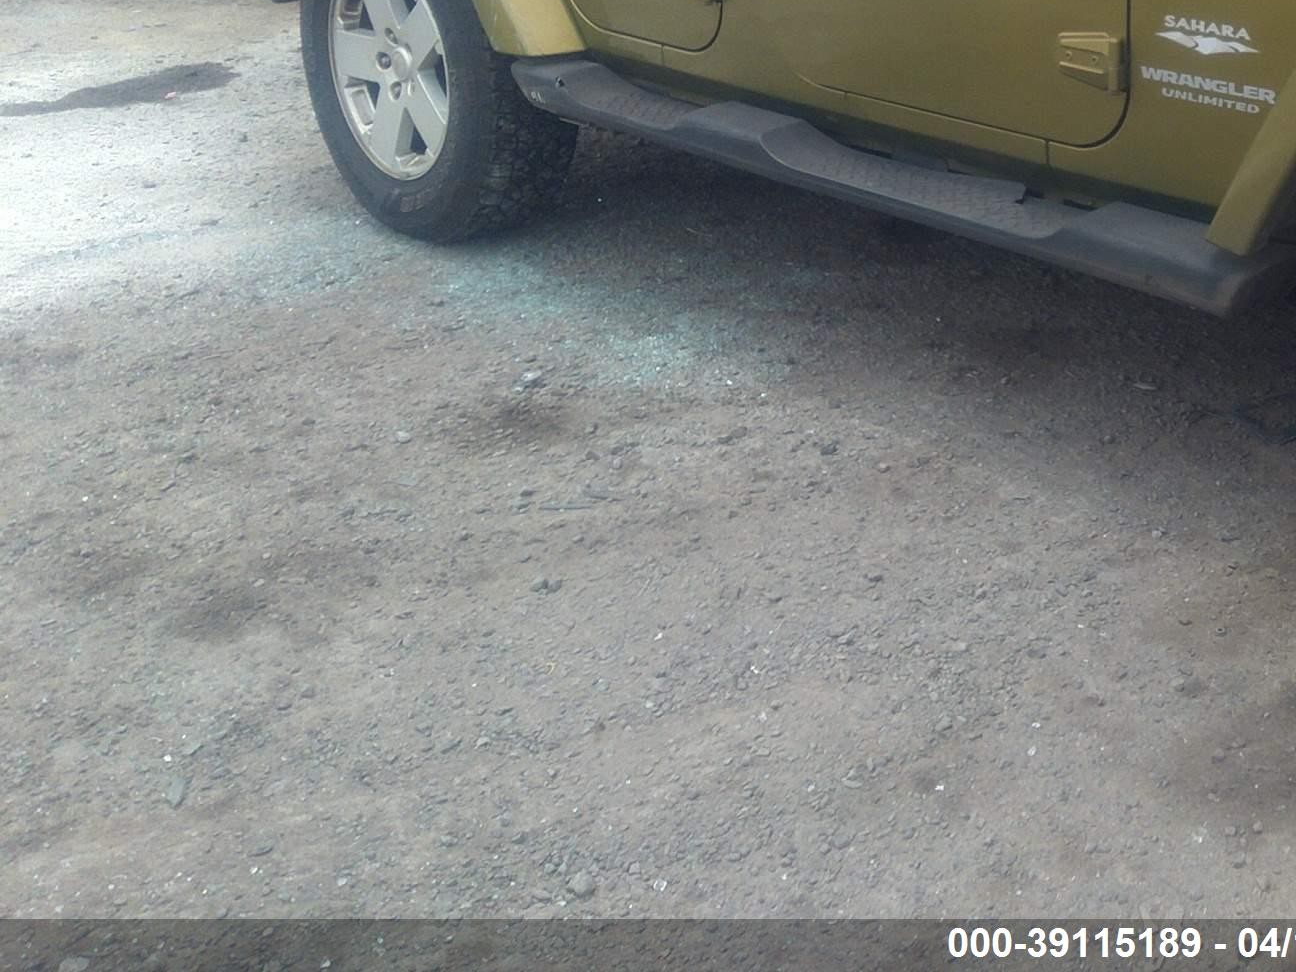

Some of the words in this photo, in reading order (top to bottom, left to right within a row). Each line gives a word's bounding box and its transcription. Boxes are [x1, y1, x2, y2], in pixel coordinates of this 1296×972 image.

[1164, 15, 1251, 40] SAHARA
[1140, 66, 1276, 104] WRANGLER
[1161, 87, 1260, 113] UNLIMITED
